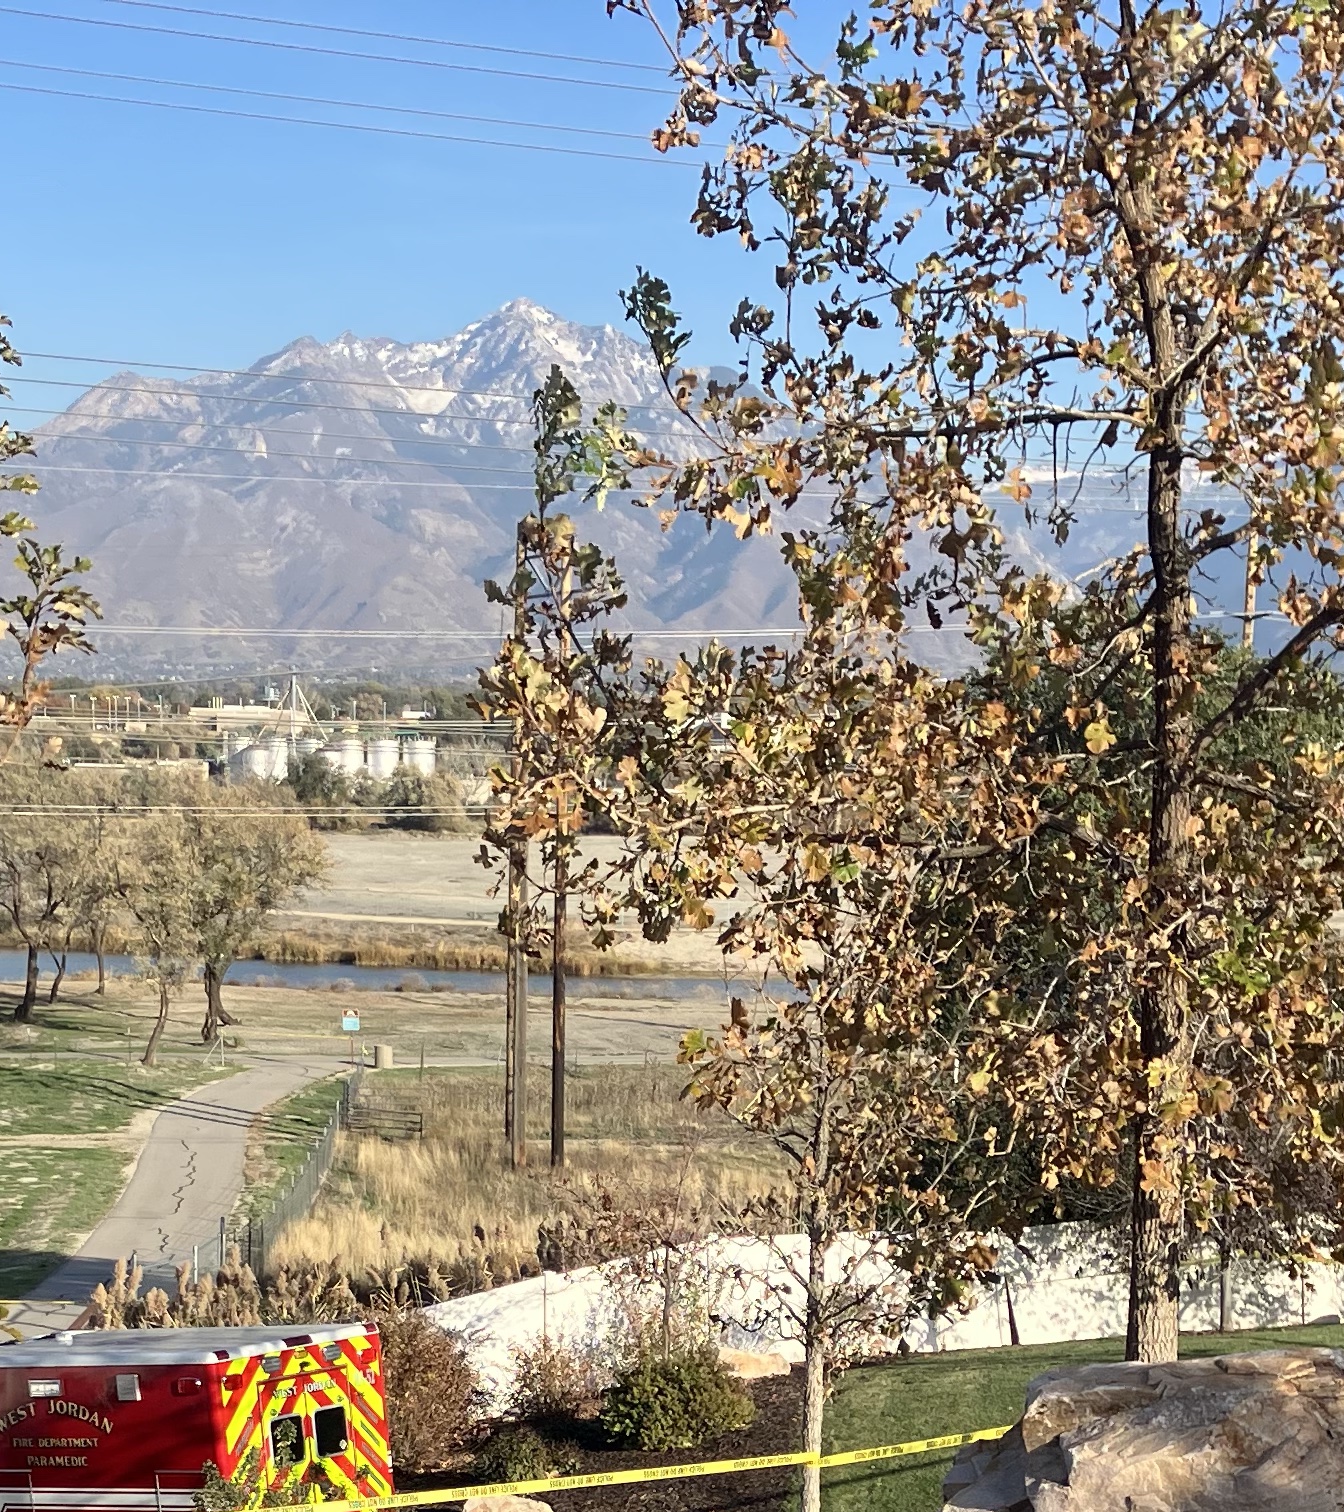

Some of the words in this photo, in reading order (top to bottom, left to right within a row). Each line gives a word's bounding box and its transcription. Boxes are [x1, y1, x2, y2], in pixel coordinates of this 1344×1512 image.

[272, 1386, 297, 1400] WEST
[303, 1378, 337, 1393] JORDAN
[47, 1399, 114, 1434] JORDAN
[12, 1437, 34, 1447] FIRE
[38, 1437, 99, 1448] DEPARTMENT
[27, 1455, 89, 1467] PARAMEDIC
